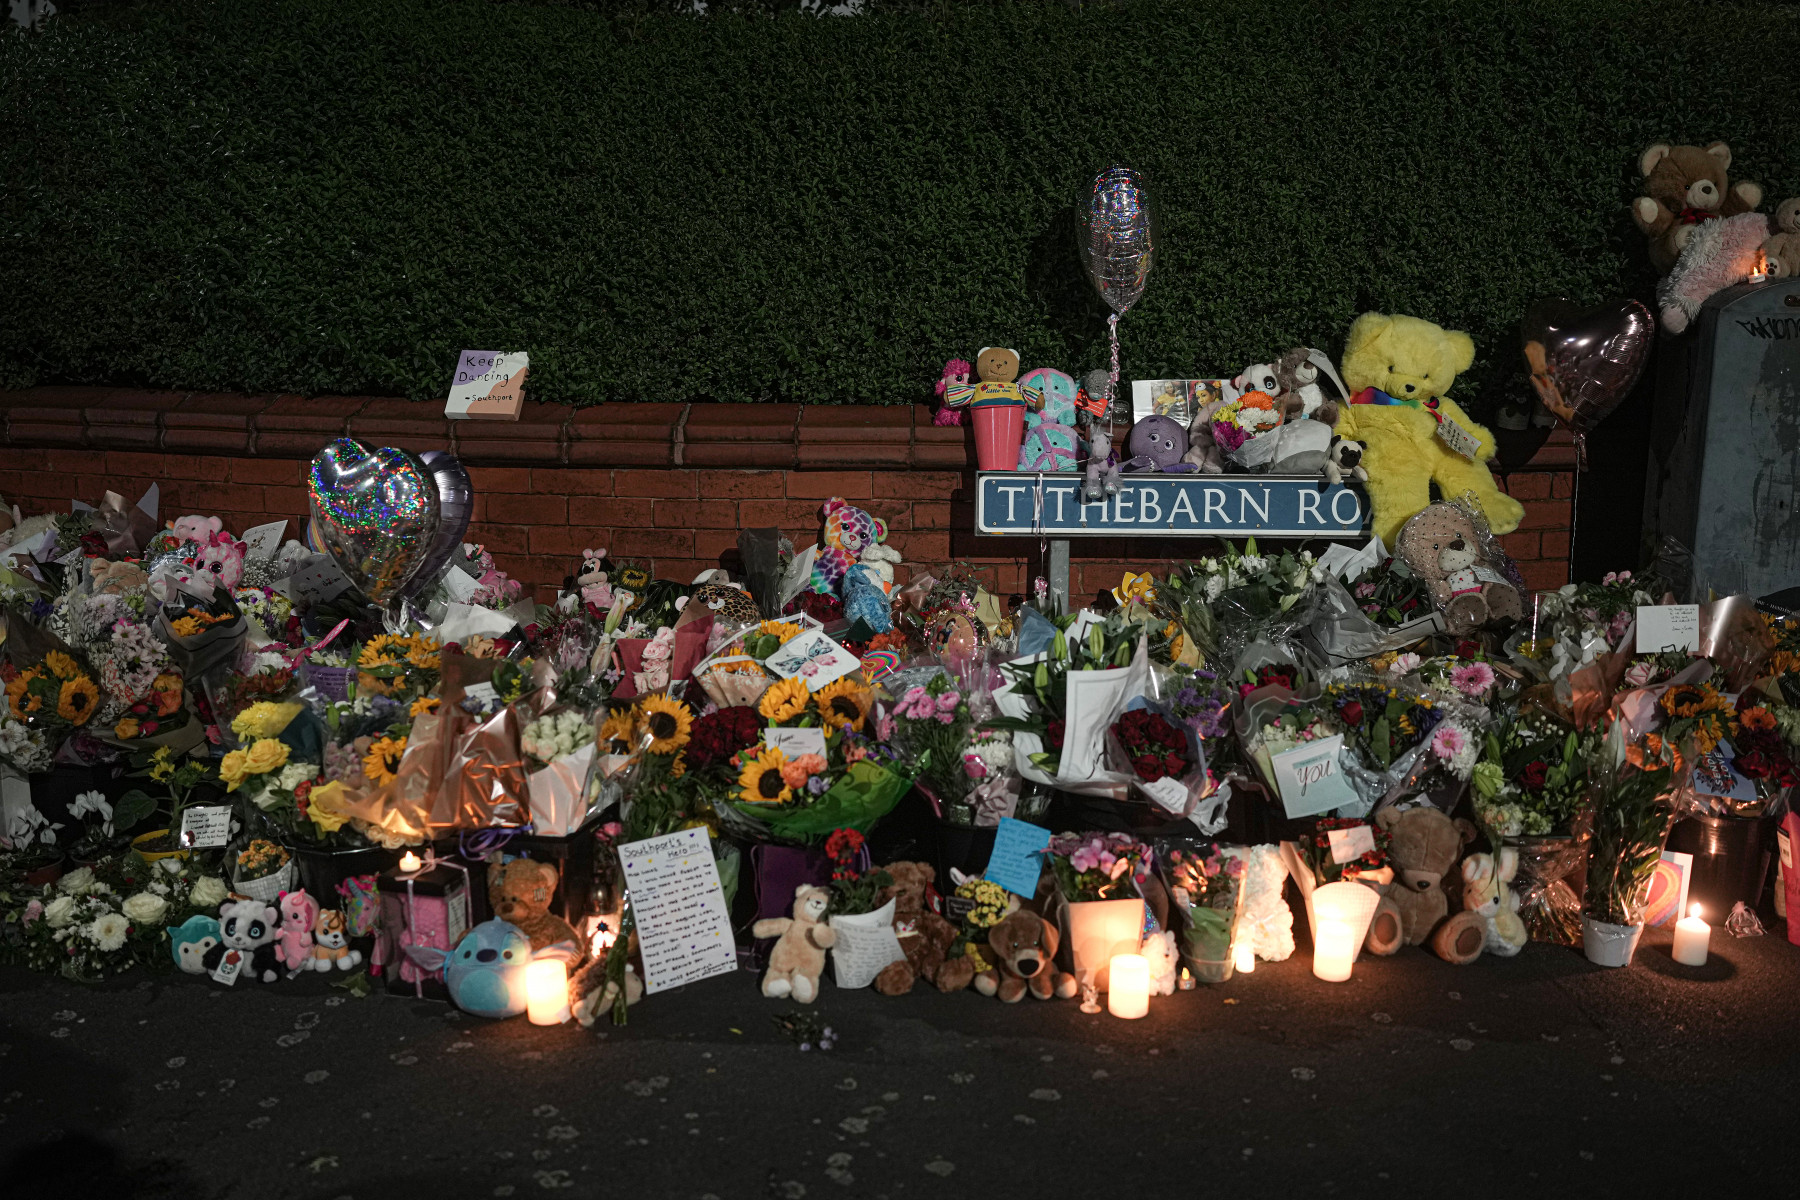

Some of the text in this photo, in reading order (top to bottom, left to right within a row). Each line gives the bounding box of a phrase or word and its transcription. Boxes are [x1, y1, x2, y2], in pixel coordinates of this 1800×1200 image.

[466, 356, 504, 368] Keep
[459, 371, 509, 388] Dancing
[471, 394, 513, 403] Southport
[997, 486, 1371, 525] TITHEBARN RO
[1714, 752, 1731, 778] LOVE
[624, 838, 682, 857] Southport's
[667, 848, 688, 858] Hero
